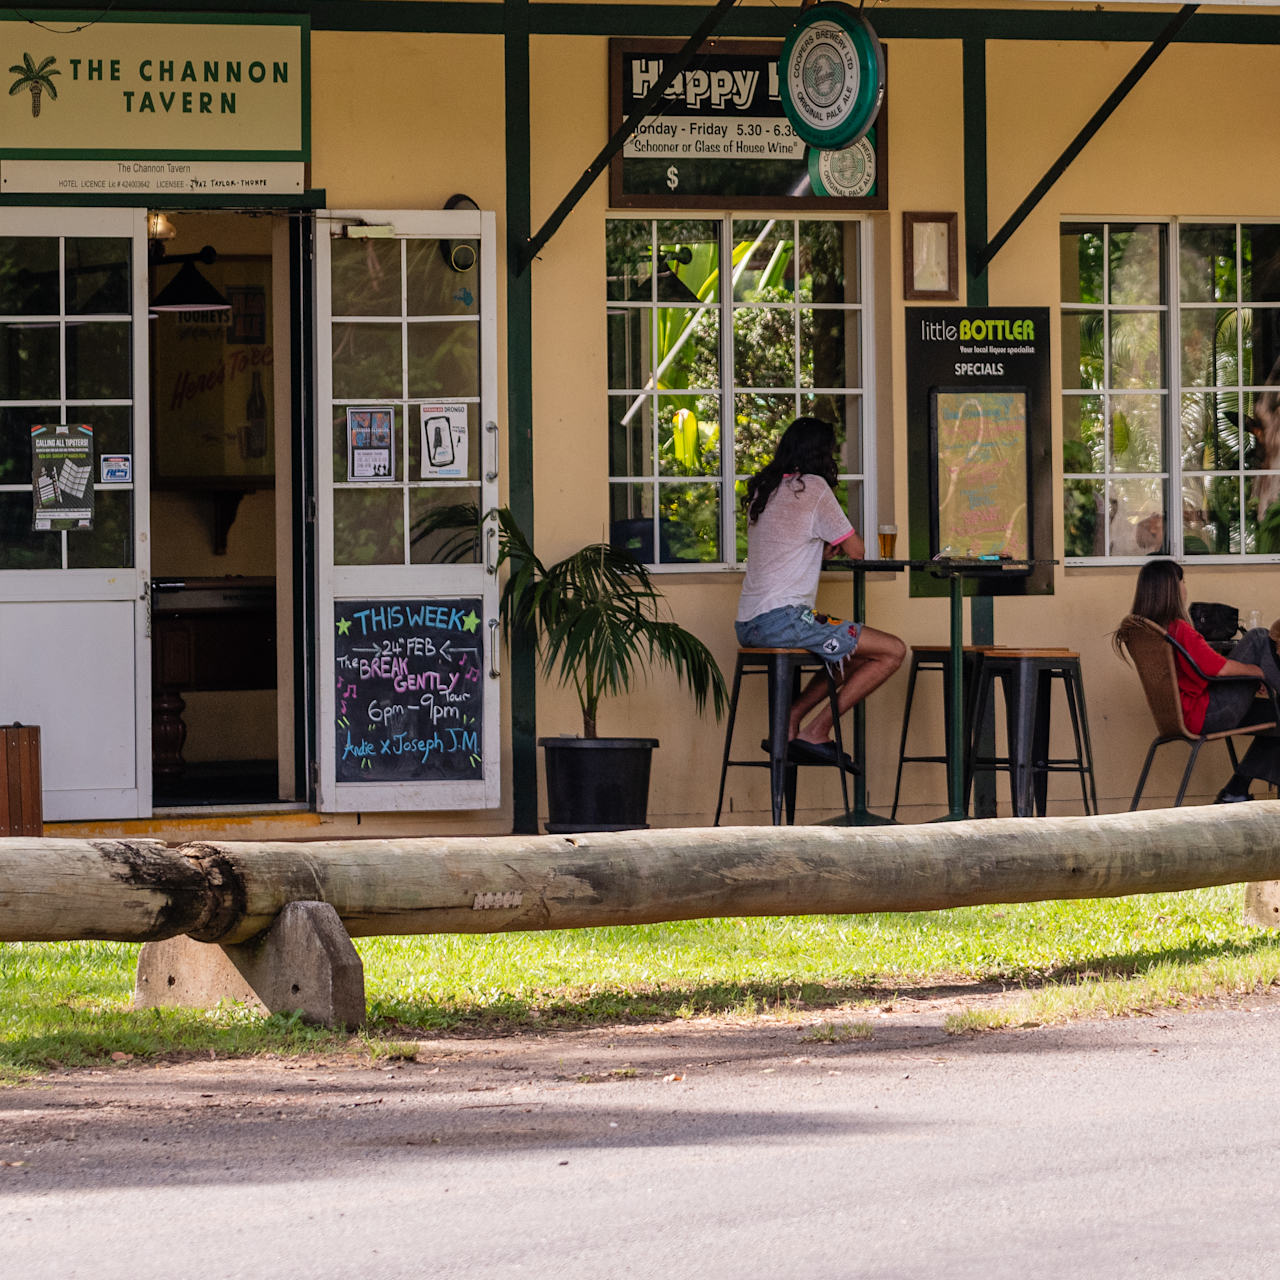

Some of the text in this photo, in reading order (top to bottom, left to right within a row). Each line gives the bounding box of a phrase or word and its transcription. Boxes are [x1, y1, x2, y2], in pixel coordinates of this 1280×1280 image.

[793, 30, 853, 79] COOPERS BREWERY LTD
[70, 58, 289, 83] THE CHANNON
[123, 91, 236, 114] TAVERN
[797, 86, 853, 121] ORIGINAL PALE ALE
[634, 123, 678, 138] onday
[690, 123, 728, 138] Friday
[737, 124, 762, 136] 5.30
[682, 143, 691, 152] or
[695, 141, 720, 153] Glass
[723, 140, 733, 153] of
[736, 141, 765, 153] House
[117, 163, 190, 173] The Channon Tavern
[666, 165, 679, 191] $
[59, 180, 78, 188] HOTEL
[178, 311, 230, 323] TOOHEYS
[921, 319, 1035, 341] little BOTTLER
[960, 345, 1035, 355] Your local liquor specialist
[955, 363, 1004, 376] SPECIALS
[36, 439, 55, 447] CALLING
[56, 439, 65, 447] ALL
[353, 606, 465, 636] THIS WEEK
[406, 637, 436, 656] FEB
[337, 655, 409, 680] The BREAK
[393, 671, 470, 702] GENTLY Tour
[368, 700, 404, 726] 6pm
[420, 693, 460, 726] 9pm
[393, 731, 444, 764] Joseph
